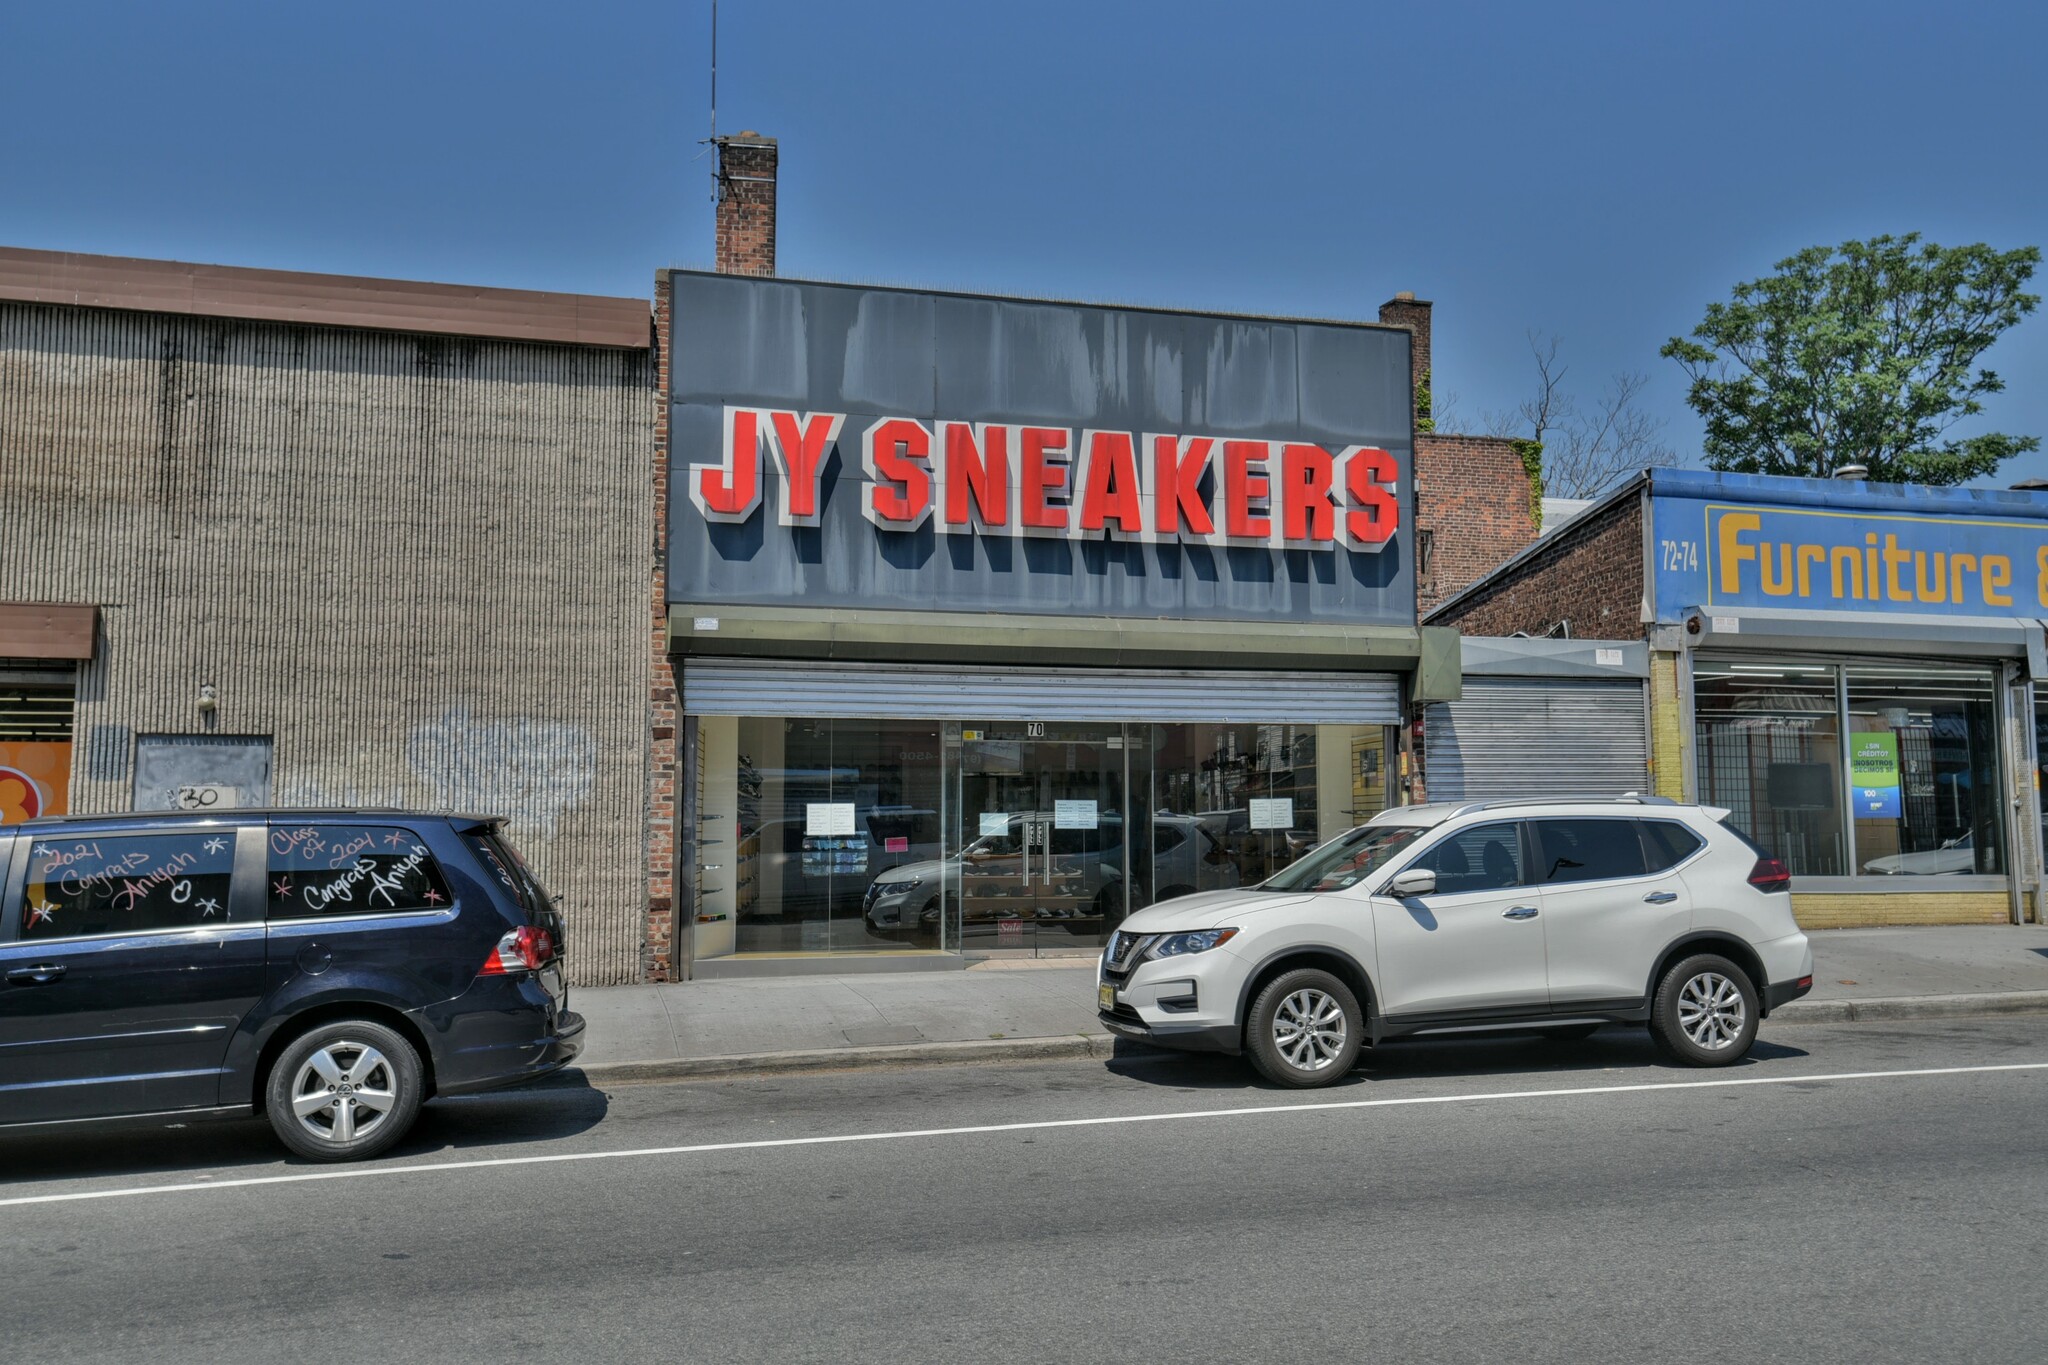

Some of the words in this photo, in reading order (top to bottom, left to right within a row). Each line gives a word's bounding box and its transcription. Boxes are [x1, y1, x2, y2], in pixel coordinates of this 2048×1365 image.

[690, 406, 846, 525] JY
[861, 417, 1398, 552] SNEAKERS
[1661, 540, 1698, 572] 72-74
[1718, 513, 2013, 607] Furniture
[1029, 723, 1043, 736] 70
[44, 843, 103, 873] 2021
[271, 828, 319, 854] Class
[329, 832, 376, 869] 2021
[61, 852, 149, 898] Congrats
[111, 852, 197, 911] Aniyah
[304, 859, 377, 910] Congrats
[369, 845, 430, 907] Aniyah
[1001, 922, 1021, 933] Sale
